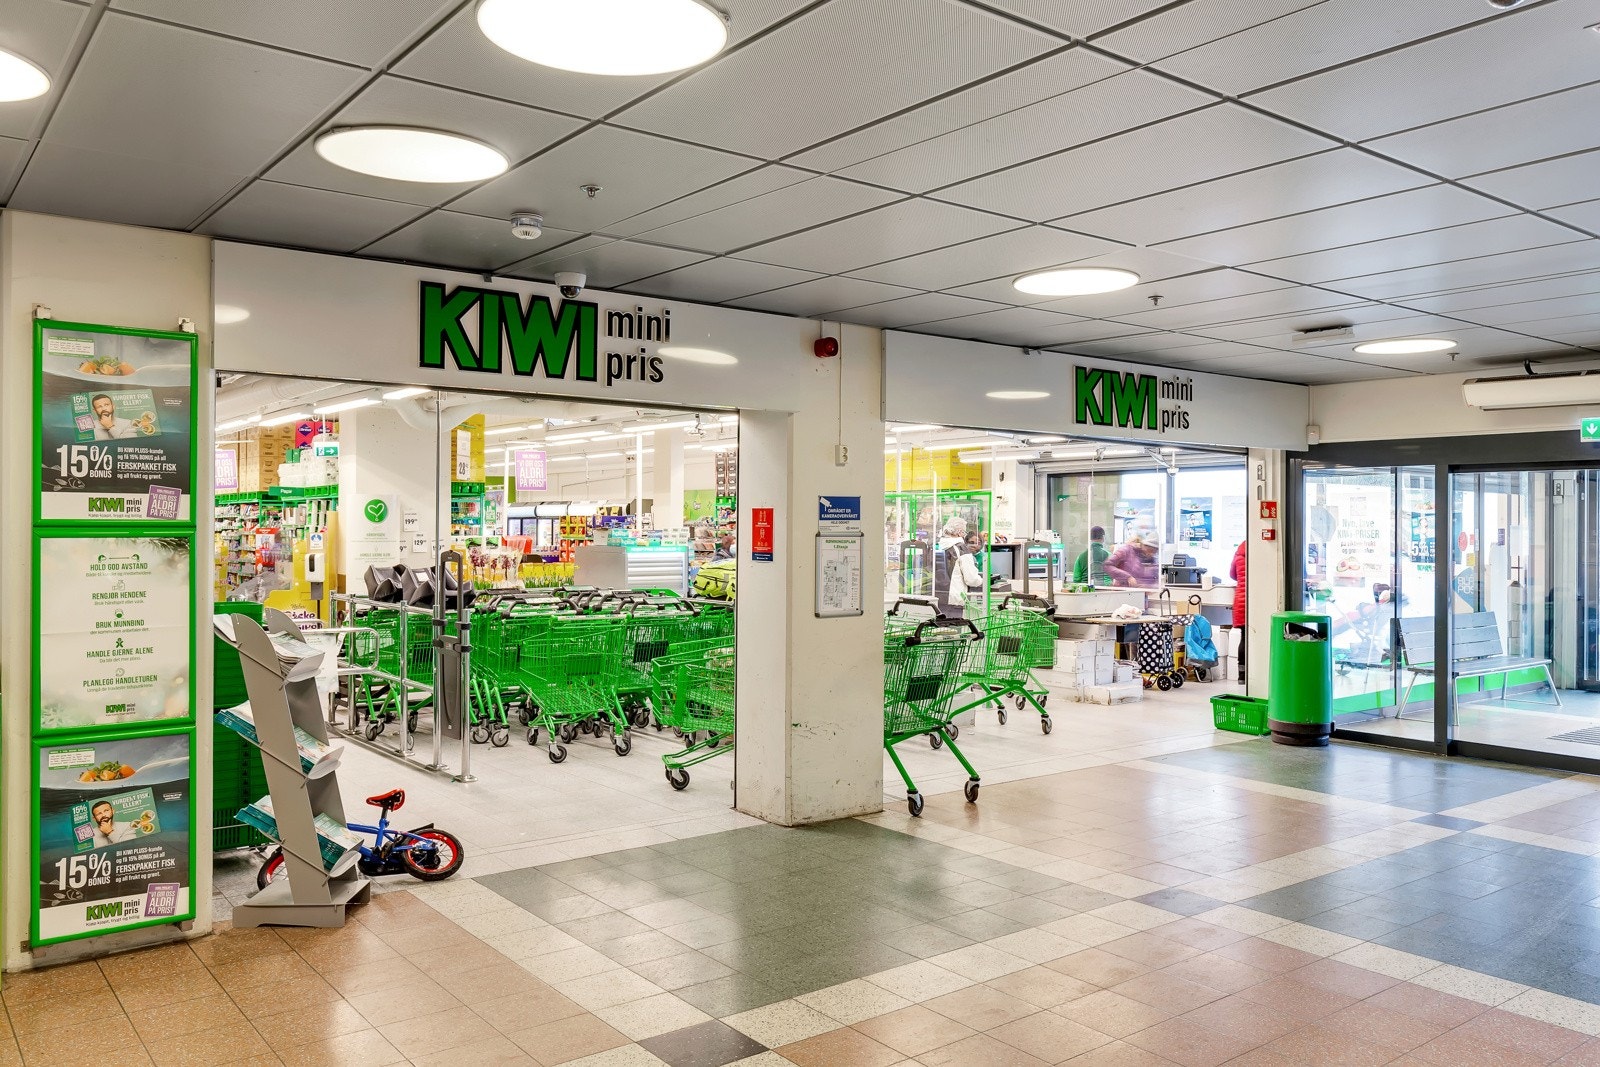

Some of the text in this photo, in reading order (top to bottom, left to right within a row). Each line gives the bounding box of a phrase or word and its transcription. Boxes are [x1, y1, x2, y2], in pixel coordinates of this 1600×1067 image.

[606, 305, 671, 342] mini
[419, 281, 598, 382] KIWI
[605, 347, 664, 386] pris
[1161, 376, 1193, 401] mini
[1074, 365, 1158, 430] KIWI
[1161, 405, 1190, 433] pris
[56, 444, 113, 478] 15%
[117, 461, 177, 471] FERSKPAKKET FISK
[89, 469, 113, 479] BONUS
[215, 465, 233, 477] DRI
[520, 468, 544, 478] ALDRI
[88, 497, 124, 512] KIWI
[126, 498, 142, 506] mini
[151, 499, 176, 511] ALDRI
[126, 505, 141, 513] pris
[150, 508, 158, 516] PÅ
[92, 592, 119, 600] RENGJØR
[95, 619, 145, 629] BRUK MUNNBIND
[86, 650, 111, 659] HANDLE
[112, 648, 134, 657] GJERNE
[82, 674, 158, 687] PLANLEGG HANDLETUREN
[55, 852, 112, 891] 15%
[116, 858, 175, 874] FERSKPAKKET FISK
[88, 876, 111, 887] BONUS
[124, 899, 140, 908] mini
[149, 897, 174, 907] ALDRI
[87, 901, 122, 921] KIWI
[124, 908, 139, 916] pris
